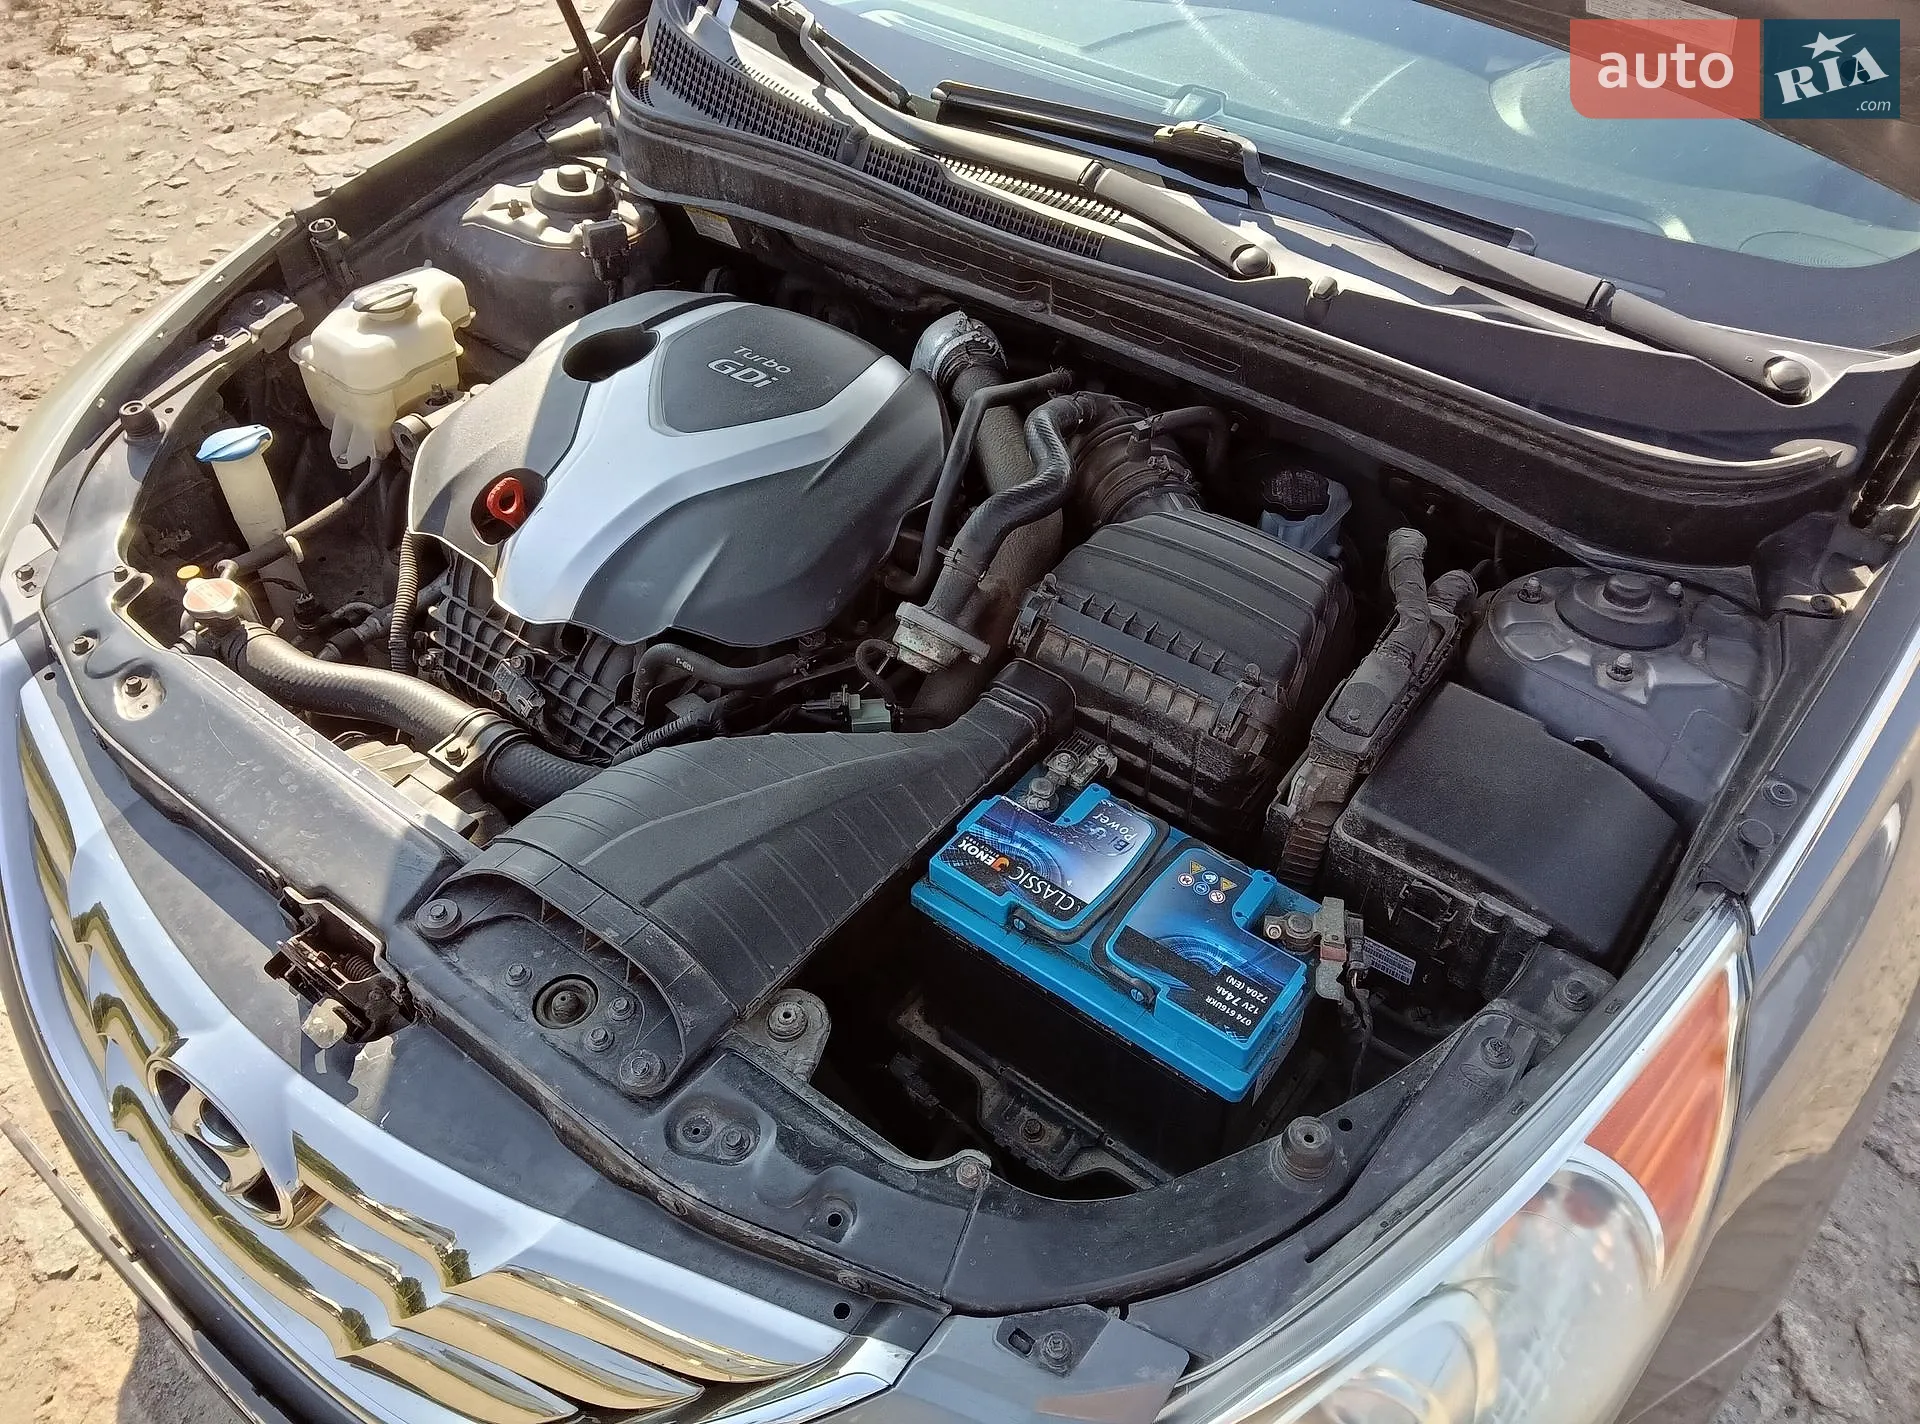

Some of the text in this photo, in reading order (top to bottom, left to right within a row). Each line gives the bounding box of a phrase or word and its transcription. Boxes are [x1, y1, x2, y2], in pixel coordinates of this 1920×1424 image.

[708, 359, 779, 388] GDi
[734, 345, 792, 373] Turbo
[1092, 813, 1138, 841] Power
[1008, 866, 1075, 911] CLASSIC
[1215, 985, 1260, 1015] 12V 74Ah
[1225, 975, 1269, 1004] 720A (EN)
[1205, 995, 1252, 1026] 074 616UKR
